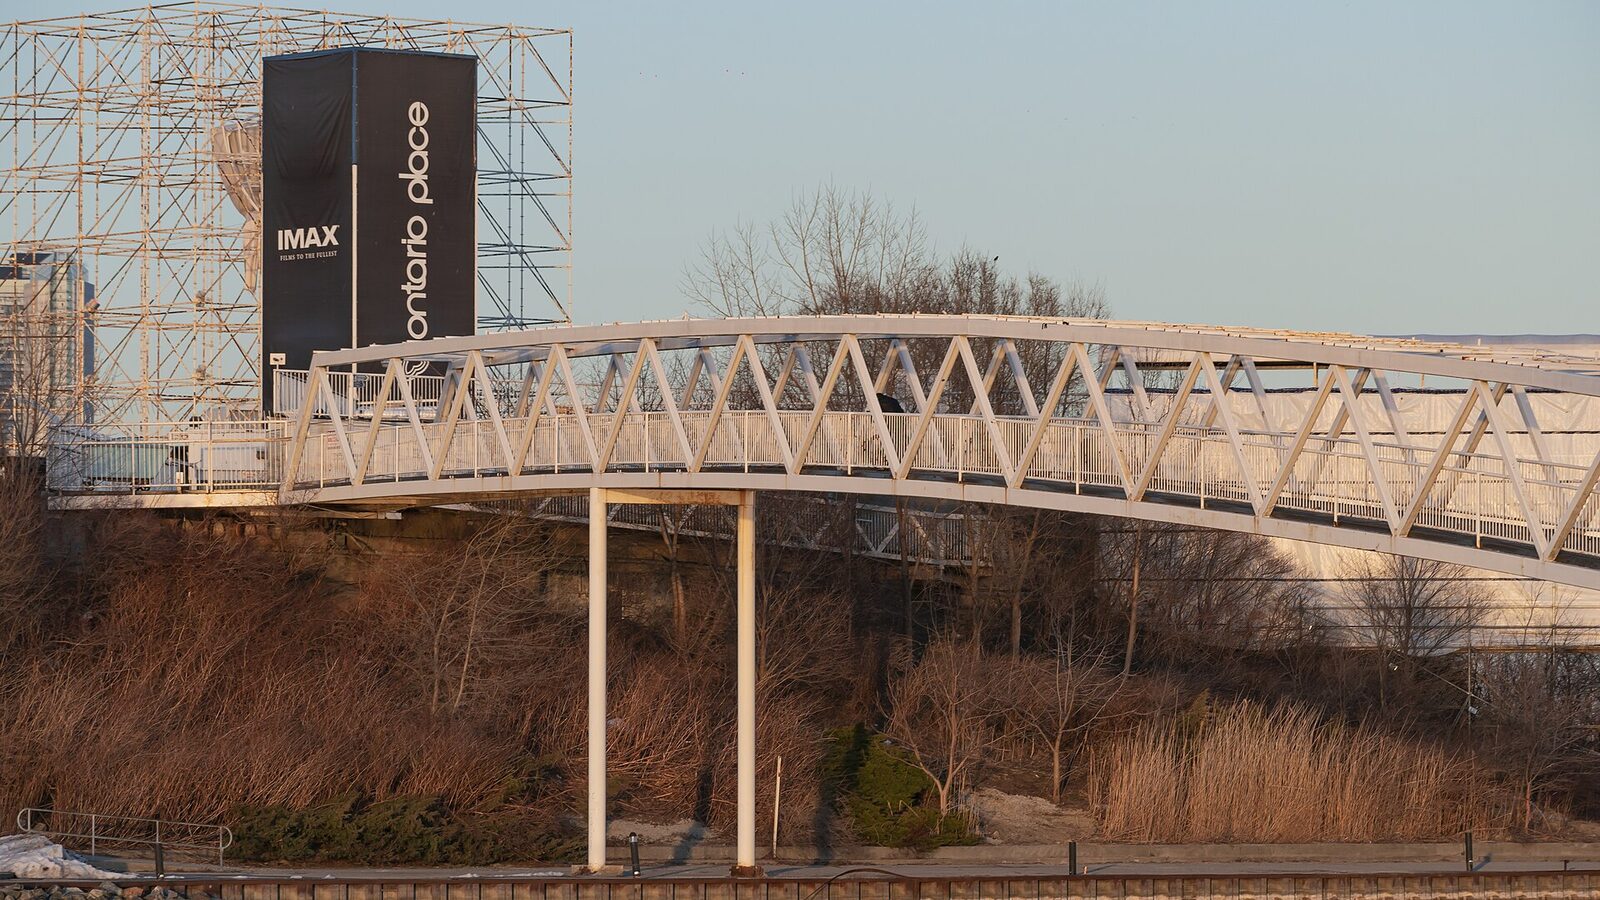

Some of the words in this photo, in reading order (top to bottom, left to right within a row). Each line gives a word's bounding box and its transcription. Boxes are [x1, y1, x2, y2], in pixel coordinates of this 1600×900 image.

[399, 101, 434, 204] place
[277, 225, 339, 251] IMAX
[316, 250, 338, 258] FULLEST
[401, 215, 428, 339] ontario
